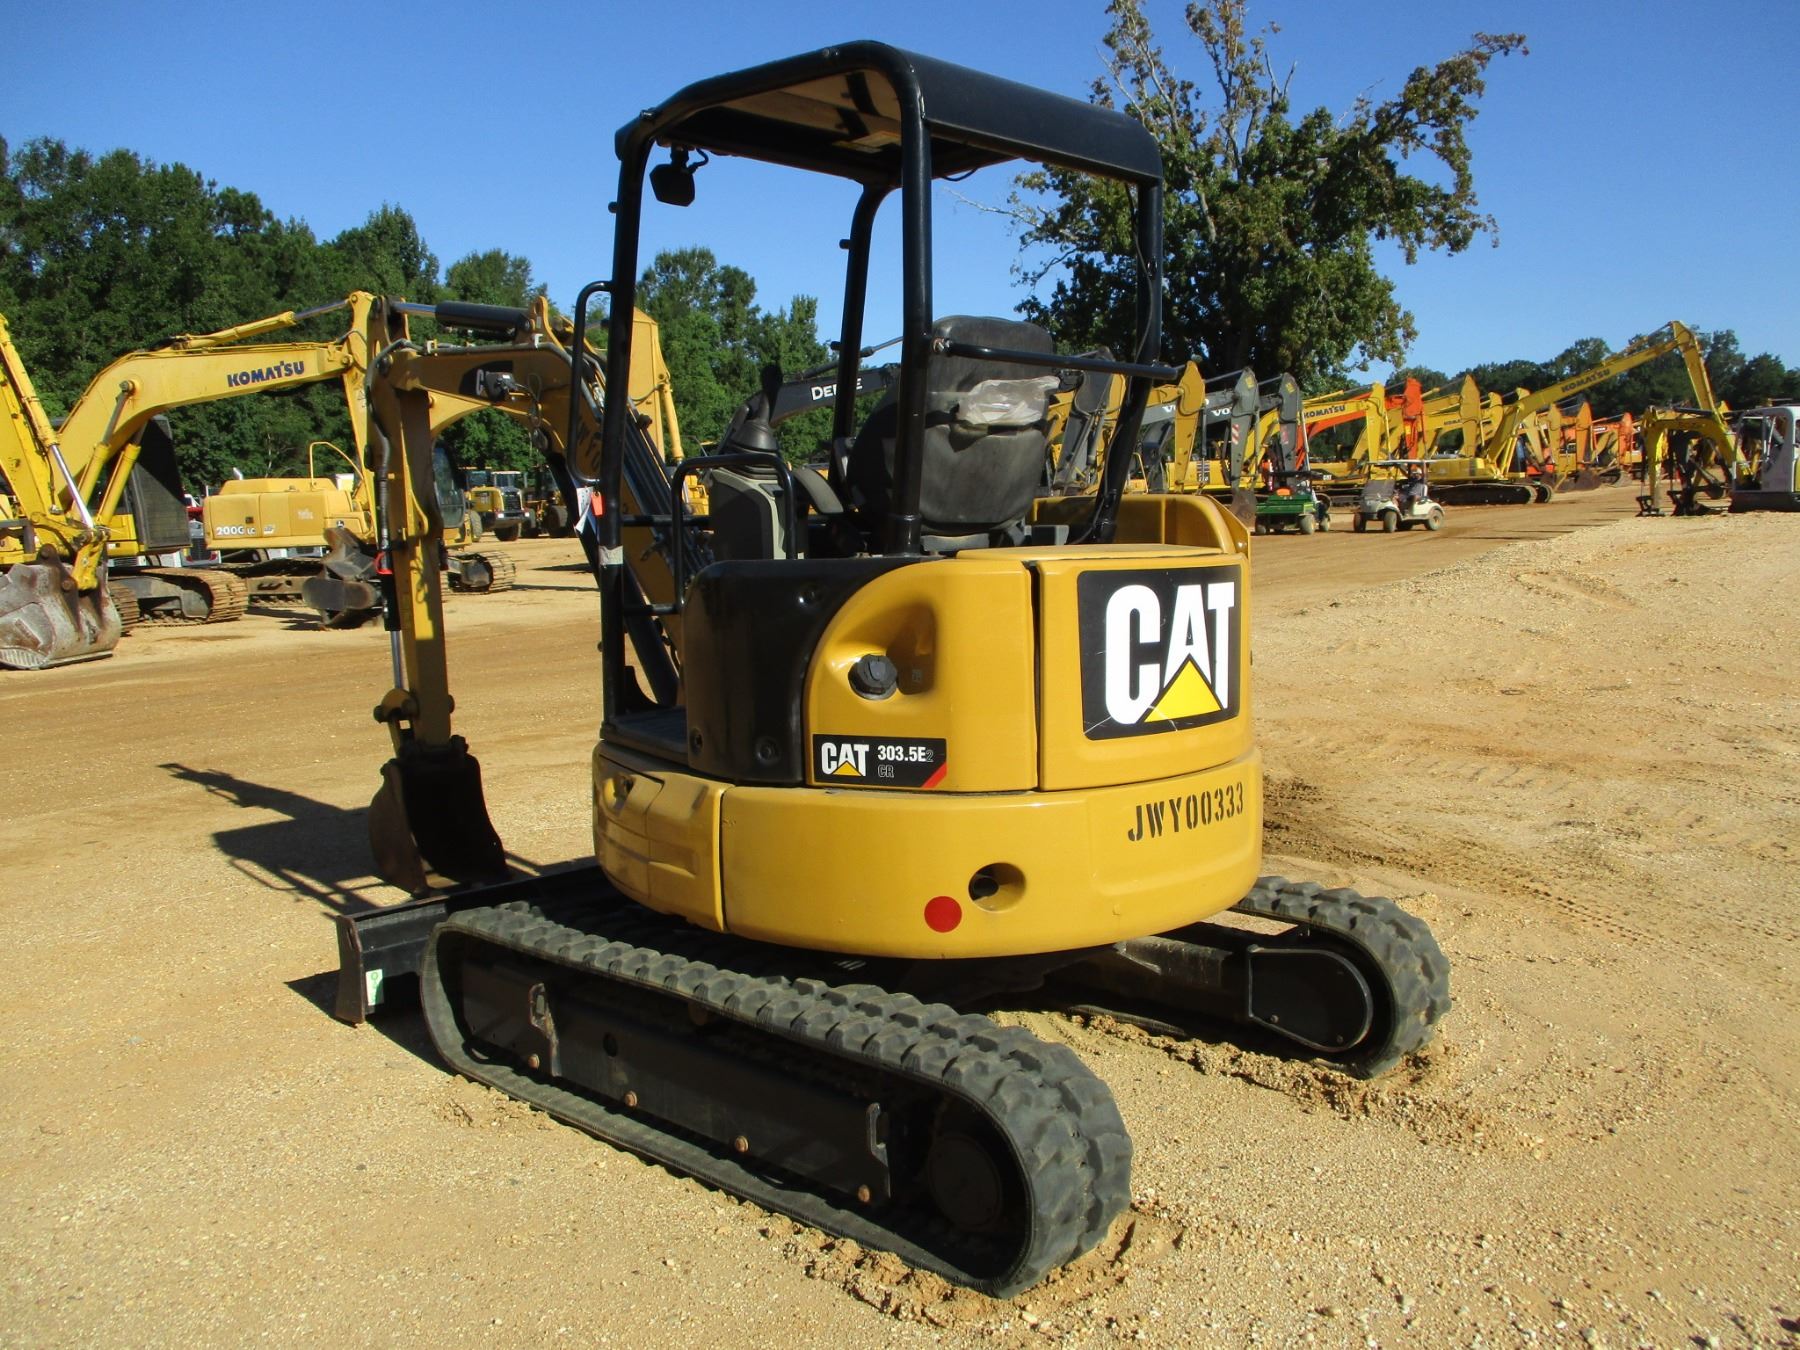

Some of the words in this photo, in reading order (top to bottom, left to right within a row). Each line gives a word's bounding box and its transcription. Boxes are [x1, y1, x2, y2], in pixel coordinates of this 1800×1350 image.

[227, 361, 305, 387] KOMATSU
[1303, 405, 1346, 418] KOMATSU
[1105, 581, 1235, 725] CAT
[821, 742, 870, 777] CAT
[877, 745, 934, 763] 303.5E2
[877, 764, 895, 778] CR
[1128, 781, 1244, 842] JWY00333
